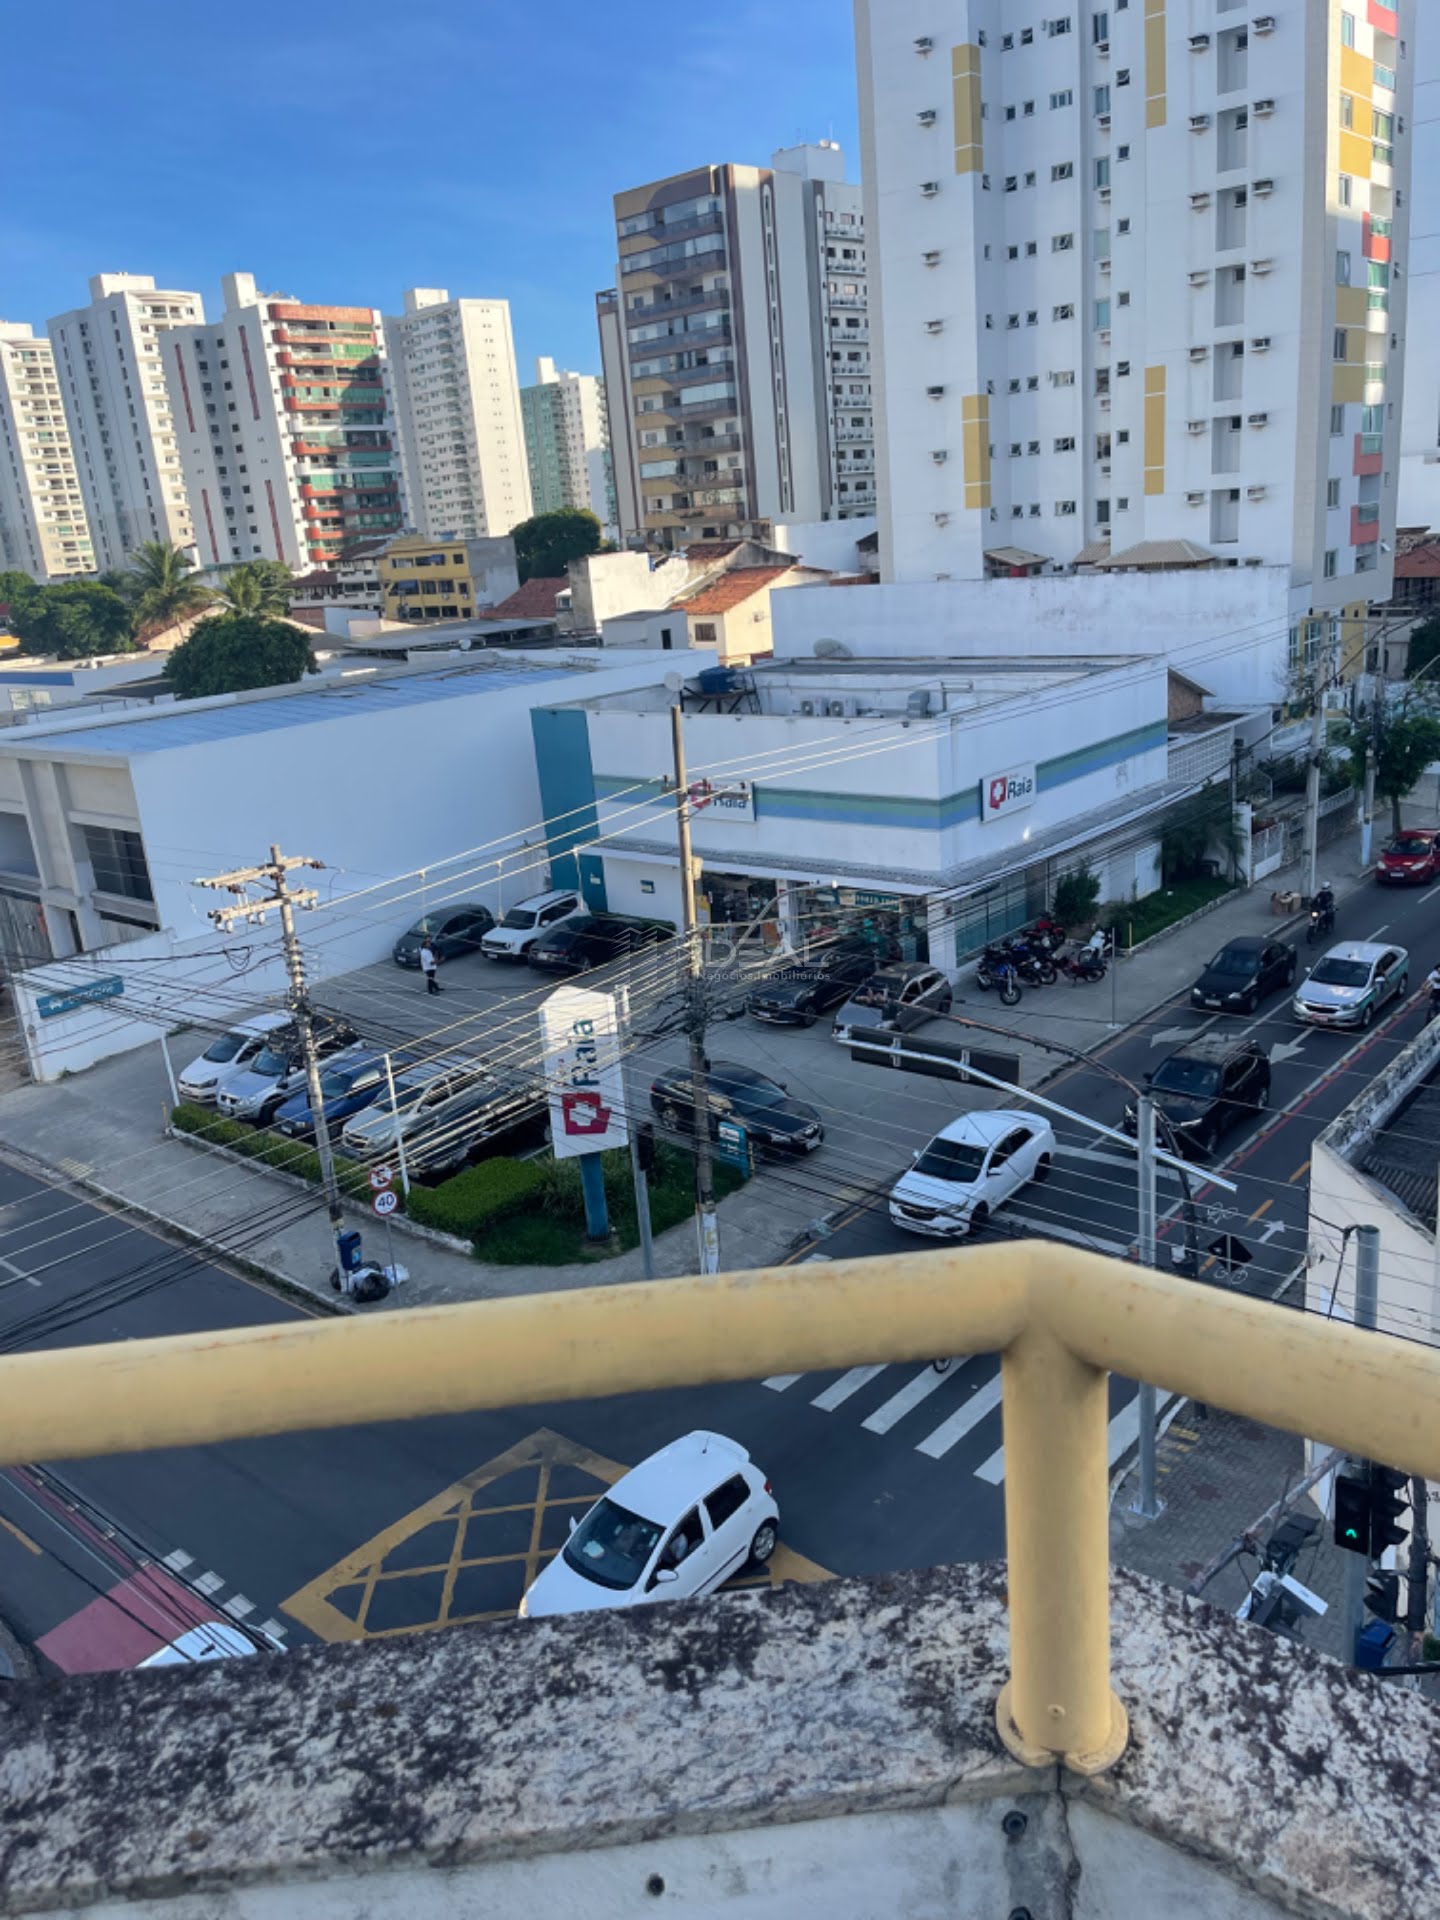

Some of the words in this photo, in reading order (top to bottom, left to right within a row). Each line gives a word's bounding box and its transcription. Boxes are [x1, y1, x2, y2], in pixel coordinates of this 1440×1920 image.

[1008, 777, 1032, 799] Raia
[571, 1019, 599, 1086] Raia
[377, 1194, 395, 1207] 40
